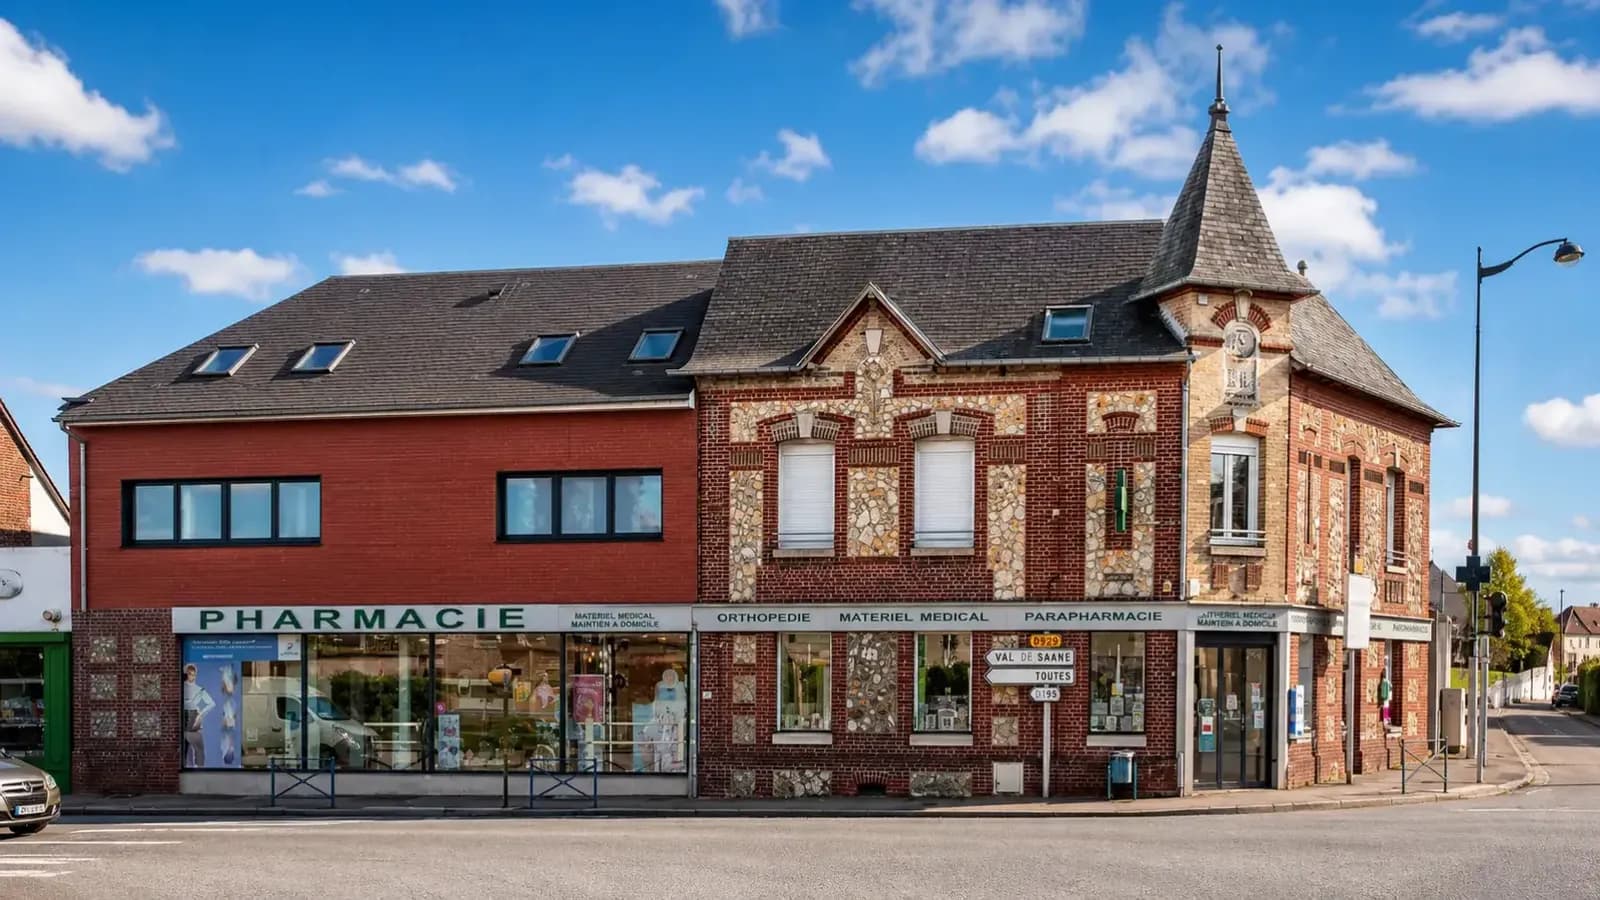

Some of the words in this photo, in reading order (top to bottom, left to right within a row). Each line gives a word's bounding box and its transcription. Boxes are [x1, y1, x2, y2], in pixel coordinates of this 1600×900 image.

[199, 608, 526, 630] PHARMACIE
[574, 612, 616, 620] MATERIEL
[618, 612, 655, 620] MEDICAL
[717, 612, 811, 623] ORTHOPEDIE
[839, 612, 913, 622] MATERIEL
[920, 611, 989, 622] MEDICAL
[1024, 611, 1162, 622] PARAPHARMACIE
[571, 620, 610, 628] MAINTIEN
[1033, 637, 1059, 646] D929
[995, 652, 1014, 662] VAL
[1021, 652, 1033, 662] DE
[1038, 652, 1071, 662] SAANE
[1035, 671, 1071, 681] TOUTES
